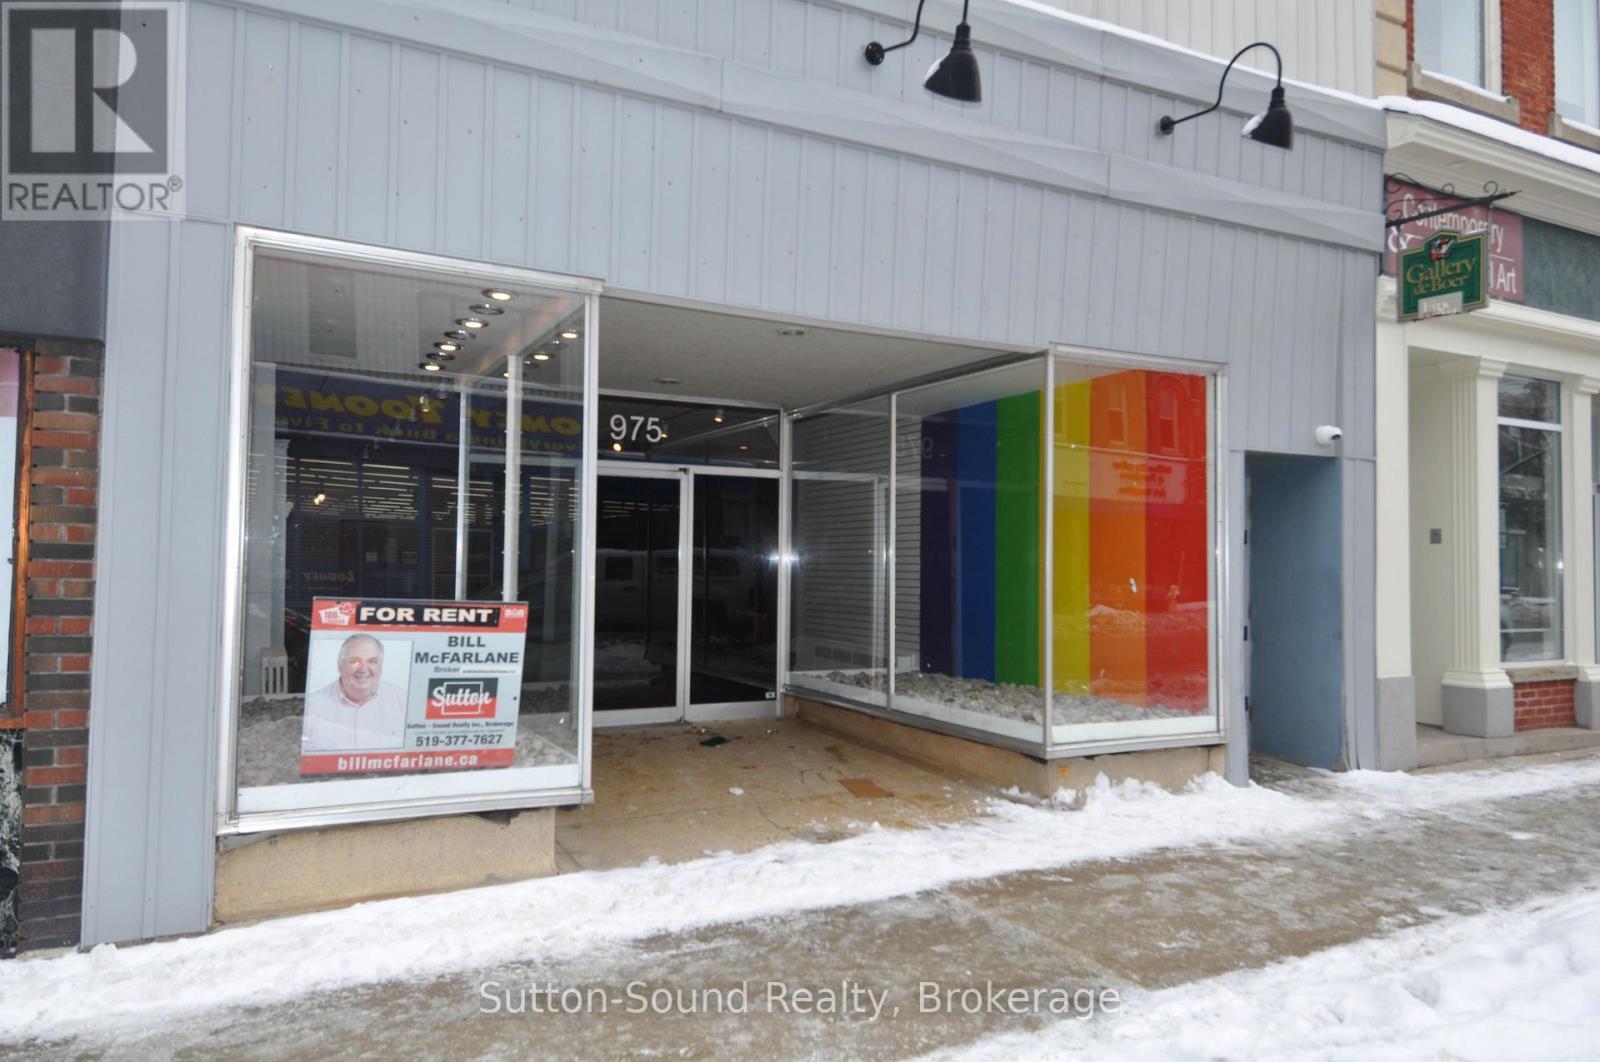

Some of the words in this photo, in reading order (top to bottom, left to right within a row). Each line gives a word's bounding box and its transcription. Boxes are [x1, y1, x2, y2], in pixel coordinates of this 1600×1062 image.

[1407, 257, 1476, 284] Gallery
[1496, 263, 1517, 294] Art
[610, 414, 662, 442] 975
[359, 607, 415, 622] FOR
[423, 608, 493, 623] RENT
[447, 636, 486, 648] BILL
[415, 652, 519, 664] McFARLANE
[431, 686, 493, 707] Sutton
[416, 734, 503, 747] 519-377-7627
[337, 754, 478, 771] billmcfarlane.ca
